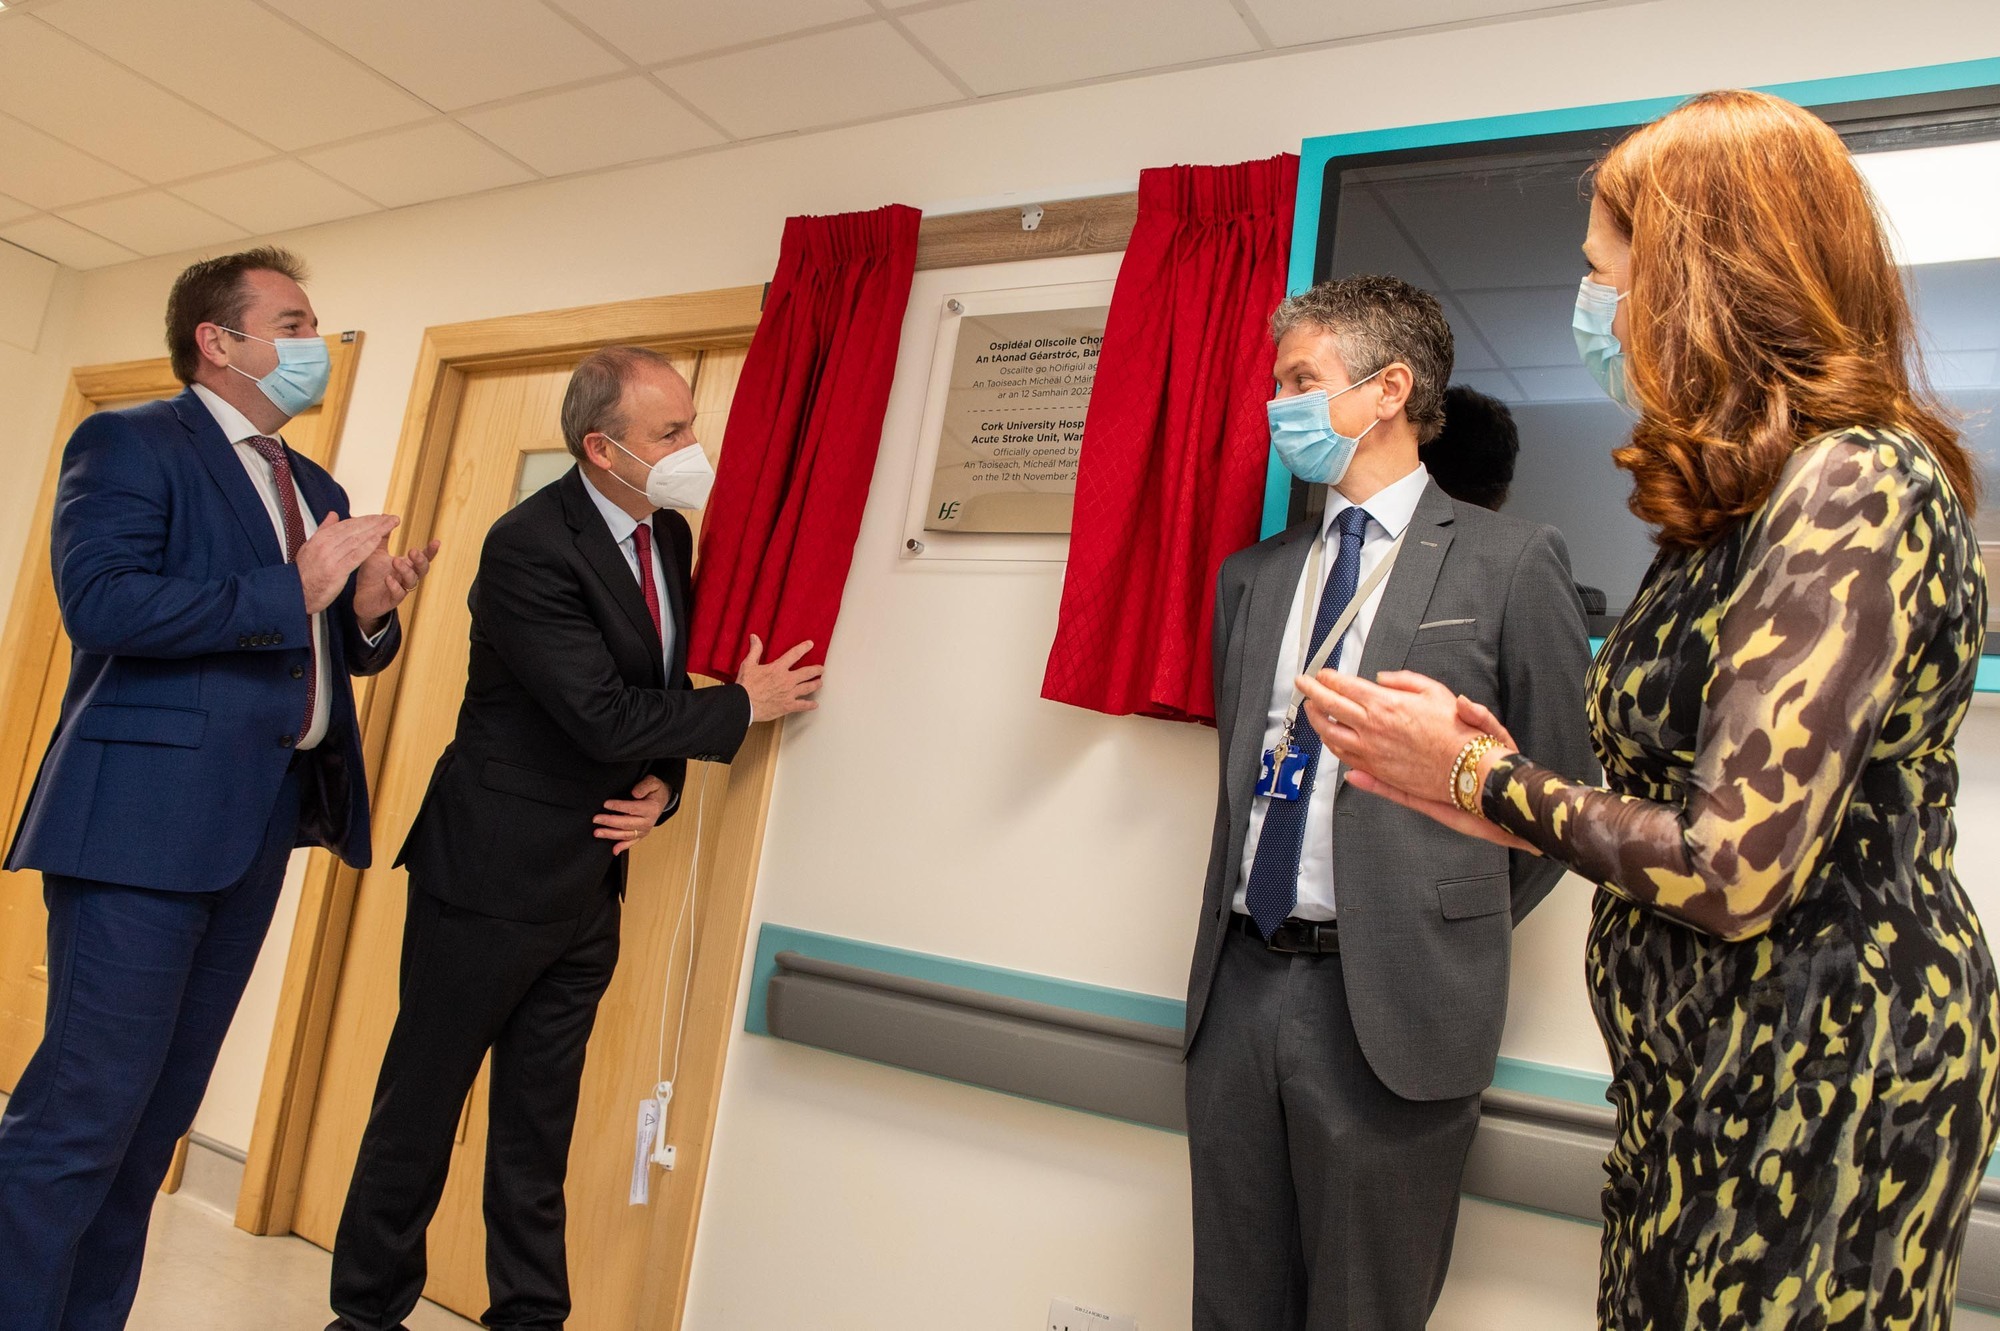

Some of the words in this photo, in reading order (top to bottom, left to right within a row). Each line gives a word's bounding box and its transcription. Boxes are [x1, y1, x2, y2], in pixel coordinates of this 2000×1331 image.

[990, 340, 1031, 351] Ospidéal
[1034, 337, 1076, 348] Ollscoile
[992, 353, 1027, 362] tAonad
[1030, 350, 1079, 360] Géarstróc,
[1083, 349, 1100, 357] Bar
[1000, 366, 1033, 375] Oscailte
[1050, 363, 1085, 372] hOifigiúl
[988, 378, 1026, 387] Taoiseach
[1064, 375, 1071, 383] Ó
[1032, 388, 1068, 397] Samhain
[982, 422, 1003, 430] Cork
[1007, 421, 1056, 430] University
[1059, 420, 1084, 429] Hosp
[972, 436, 999, 444] Acute
[1002, 434, 1033, 443] Stroke
[1037, 434, 1060, 443] Unit,
[1064, 433, 1085, 441] War
[994, 448, 1030, 457] Officially
[1033, 447, 1066, 456] opened
[1068, 447, 1079, 456] by
[978, 461, 1020, 469] Taoiseach,
